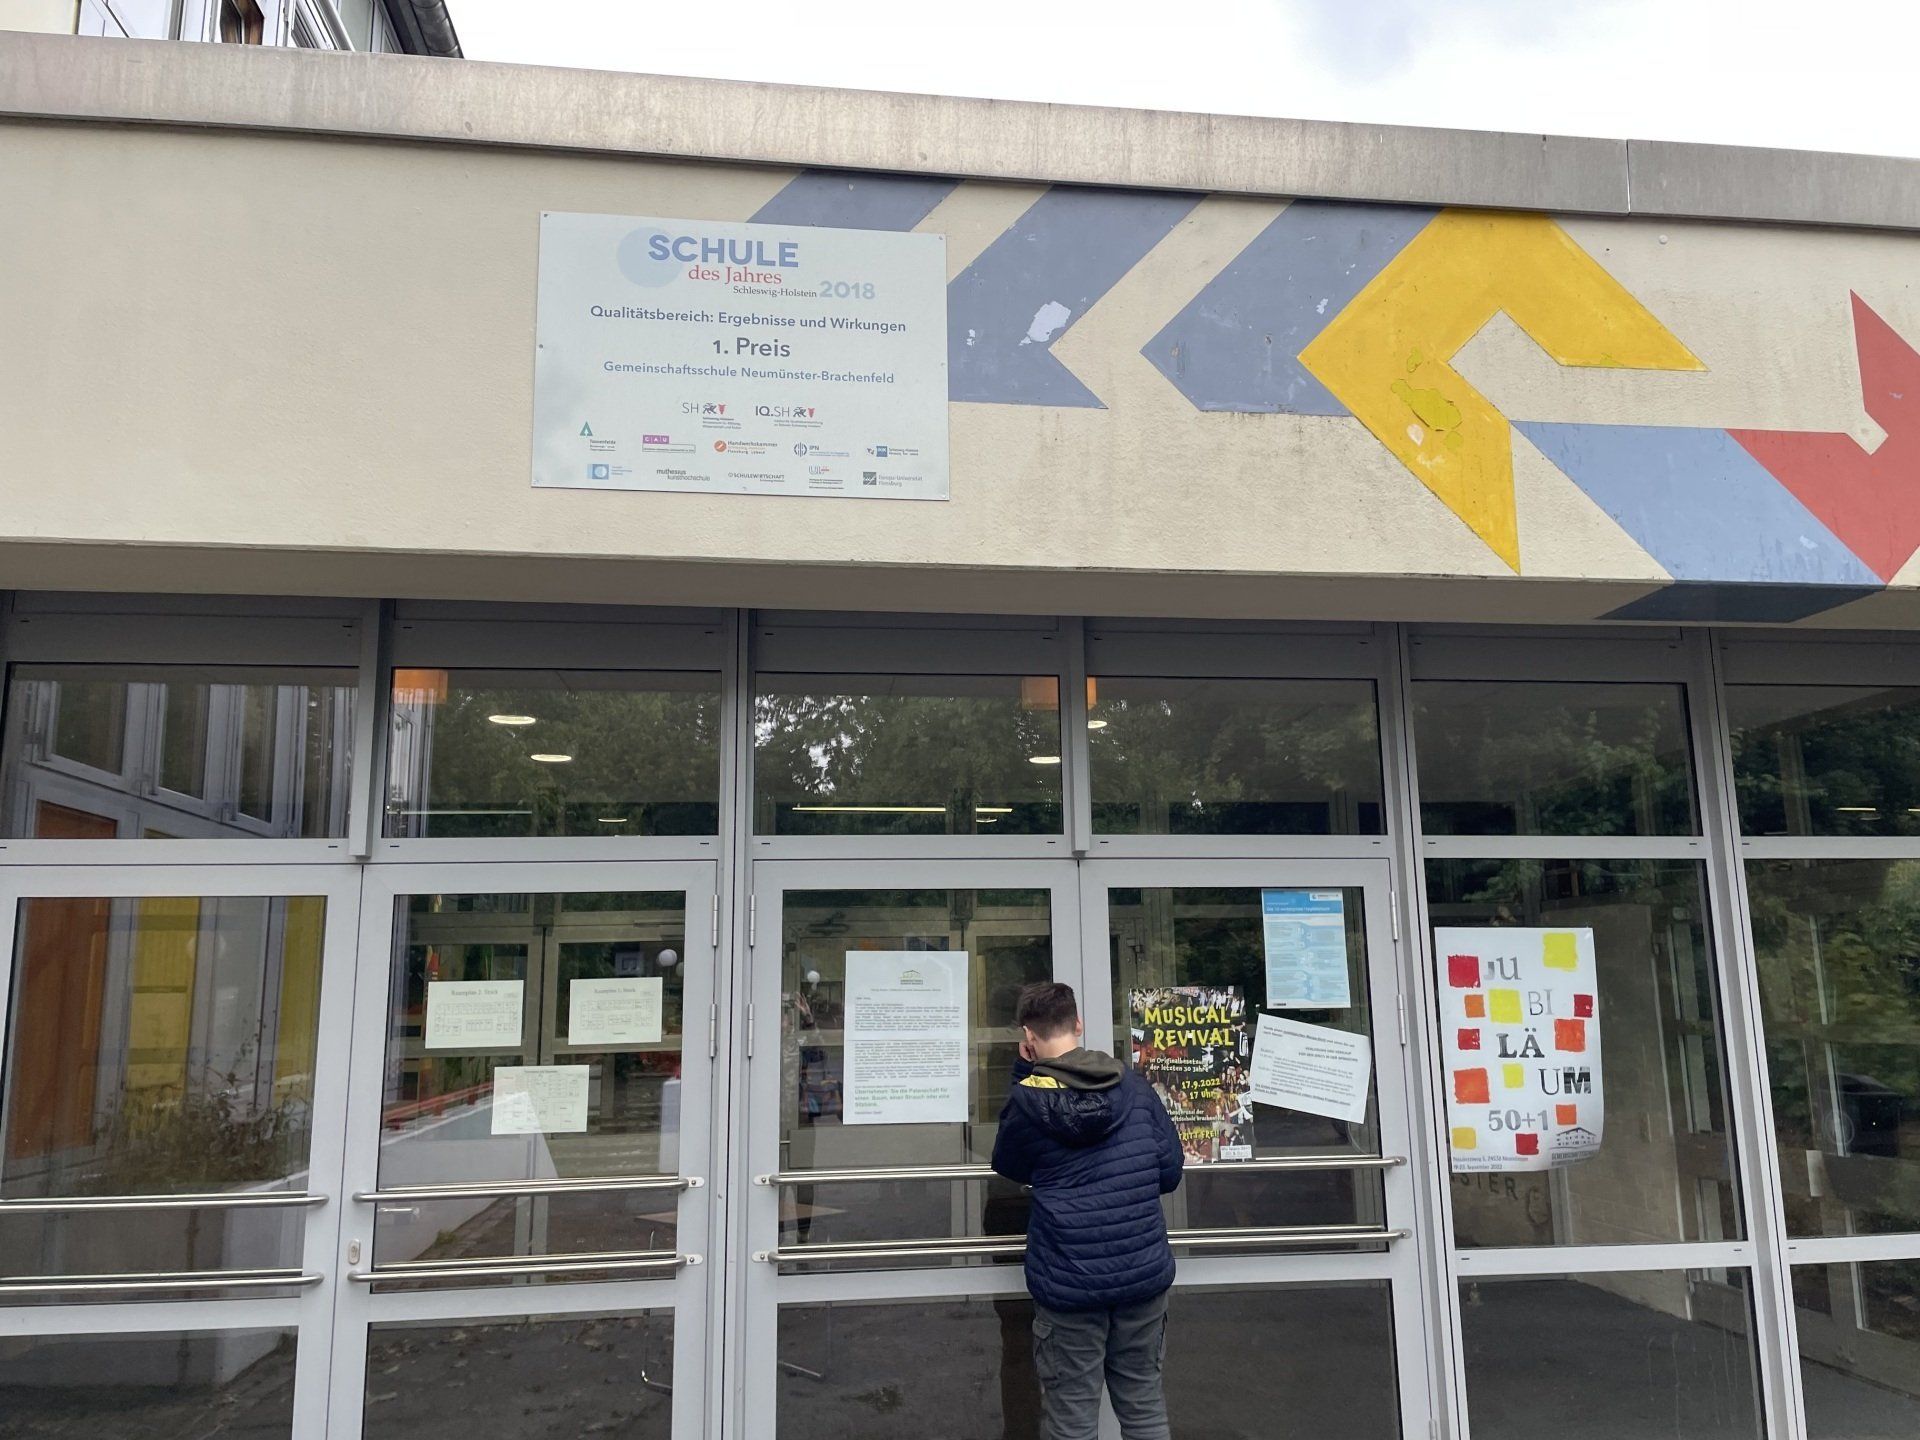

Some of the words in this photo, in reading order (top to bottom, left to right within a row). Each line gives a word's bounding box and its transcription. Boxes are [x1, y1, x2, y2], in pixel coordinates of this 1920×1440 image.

[648, 234, 800, 268] SCHULE
[688, 264, 720, 281] des
[725, 266, 783, 285] Jahres
[733, 285, 817, 298] Schleswig-Holstein
[819, 281, 876, 300] 2018
[590, 305, 714, 323] Qualitätsbereich:
[718, 311, 796, 328] Ergebnisse
[799, 316, 827, 329] und
[830, 317, 907, 334] Wirkungen
[712, 339, 729, 354] 1.
[736, 337, 791, 358] Preis
[603, 360, 737, 378] Gemeinschaftsschule
[741, 366, 895, 384] Neumünster-Brachenfeld
[681, 402, 699, 414] SH
[755, 405, 790, 418] IQ.SH
[1528, 989, 1553, 1016] BI
[1144, 1004, 1231, 1027] MUSICAL
[1153, 1028, 1235, 1051] REVIVAL
[1496, 1027, 1546, 1059] LÄ
[1182, 1078, 1221, 1090] 17.9.2022
[1538, 1066, 1592, 1096] UM
[1189, 1091, 1199, 1100] 17
[1488, 1109, 1549, 1132] 50+1
